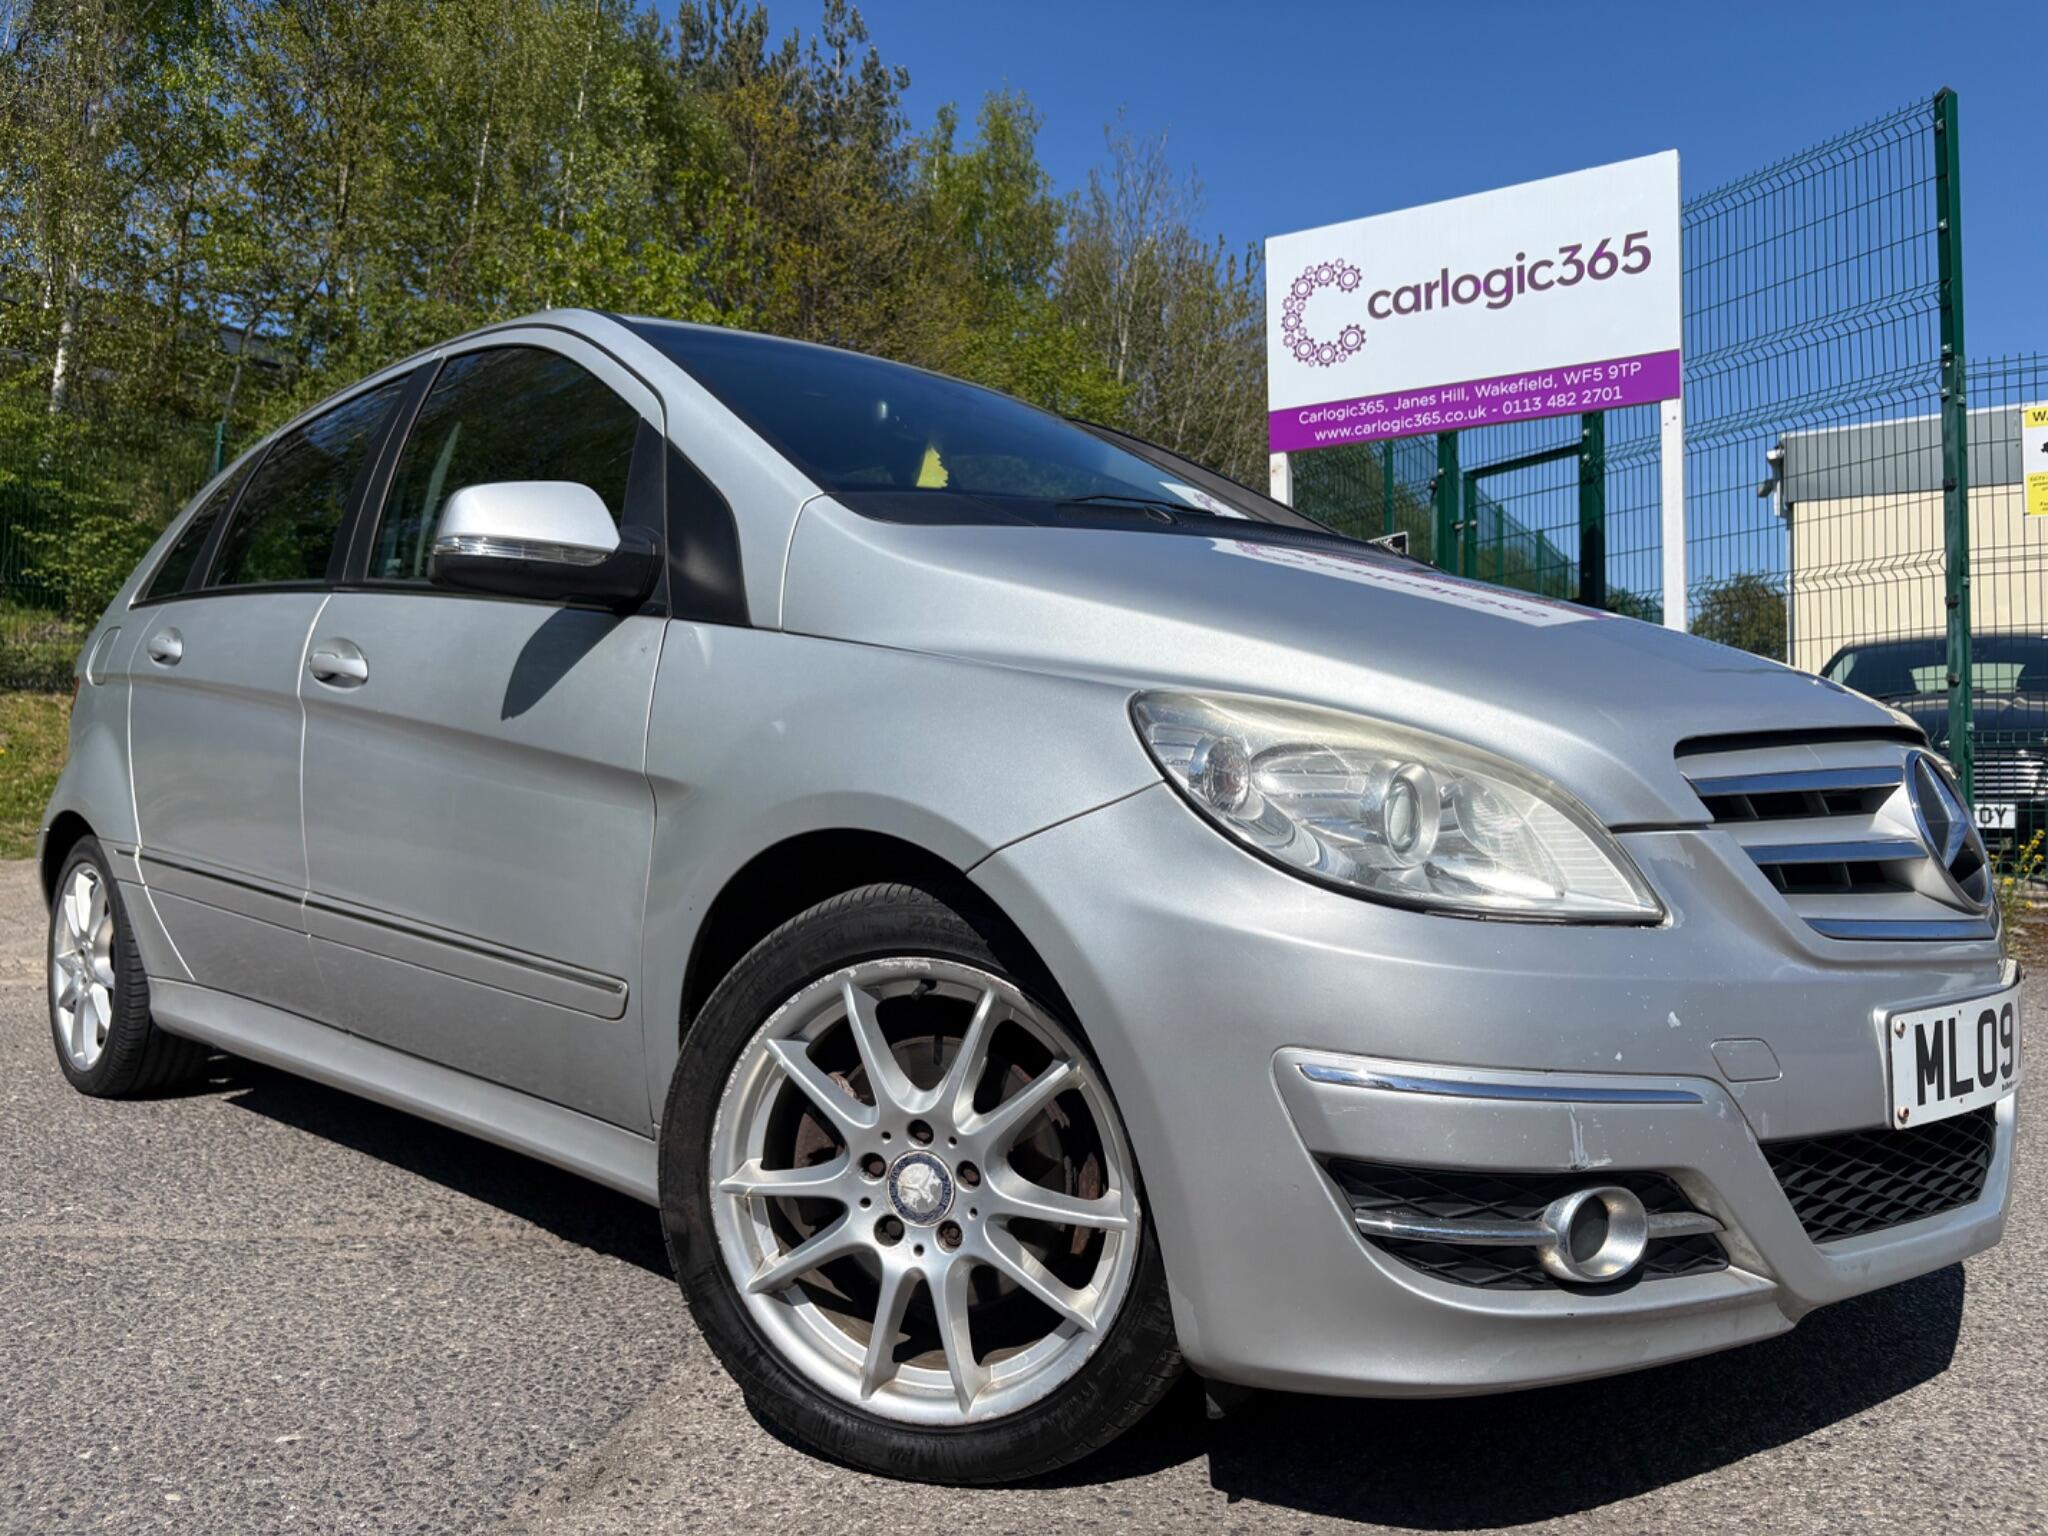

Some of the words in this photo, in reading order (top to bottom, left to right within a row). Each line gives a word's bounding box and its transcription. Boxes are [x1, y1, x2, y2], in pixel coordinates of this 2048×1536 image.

[1367, 230, 1652, 320] carlogic365
[1298, 400, 1389, 425] Carlogic365,
[1393, 393, 1437, 411] Janes
[1440, 387, 1470, 404] Hill,
[1474, 373, 1558, 399] Wakefield,
[1563, 367, 1604, 386] WF5
[1608, 362, 1642, 380] 9TP
[1314, 406, 1487, 442] www.carlogic365.co.uk
[1502, 397, 1543, 415] 0113
[1546, 392, 1577, 408] 482
[1581, 386, 1623, 405] 2701
[1915, 1002, 2013, 1106] ML09
